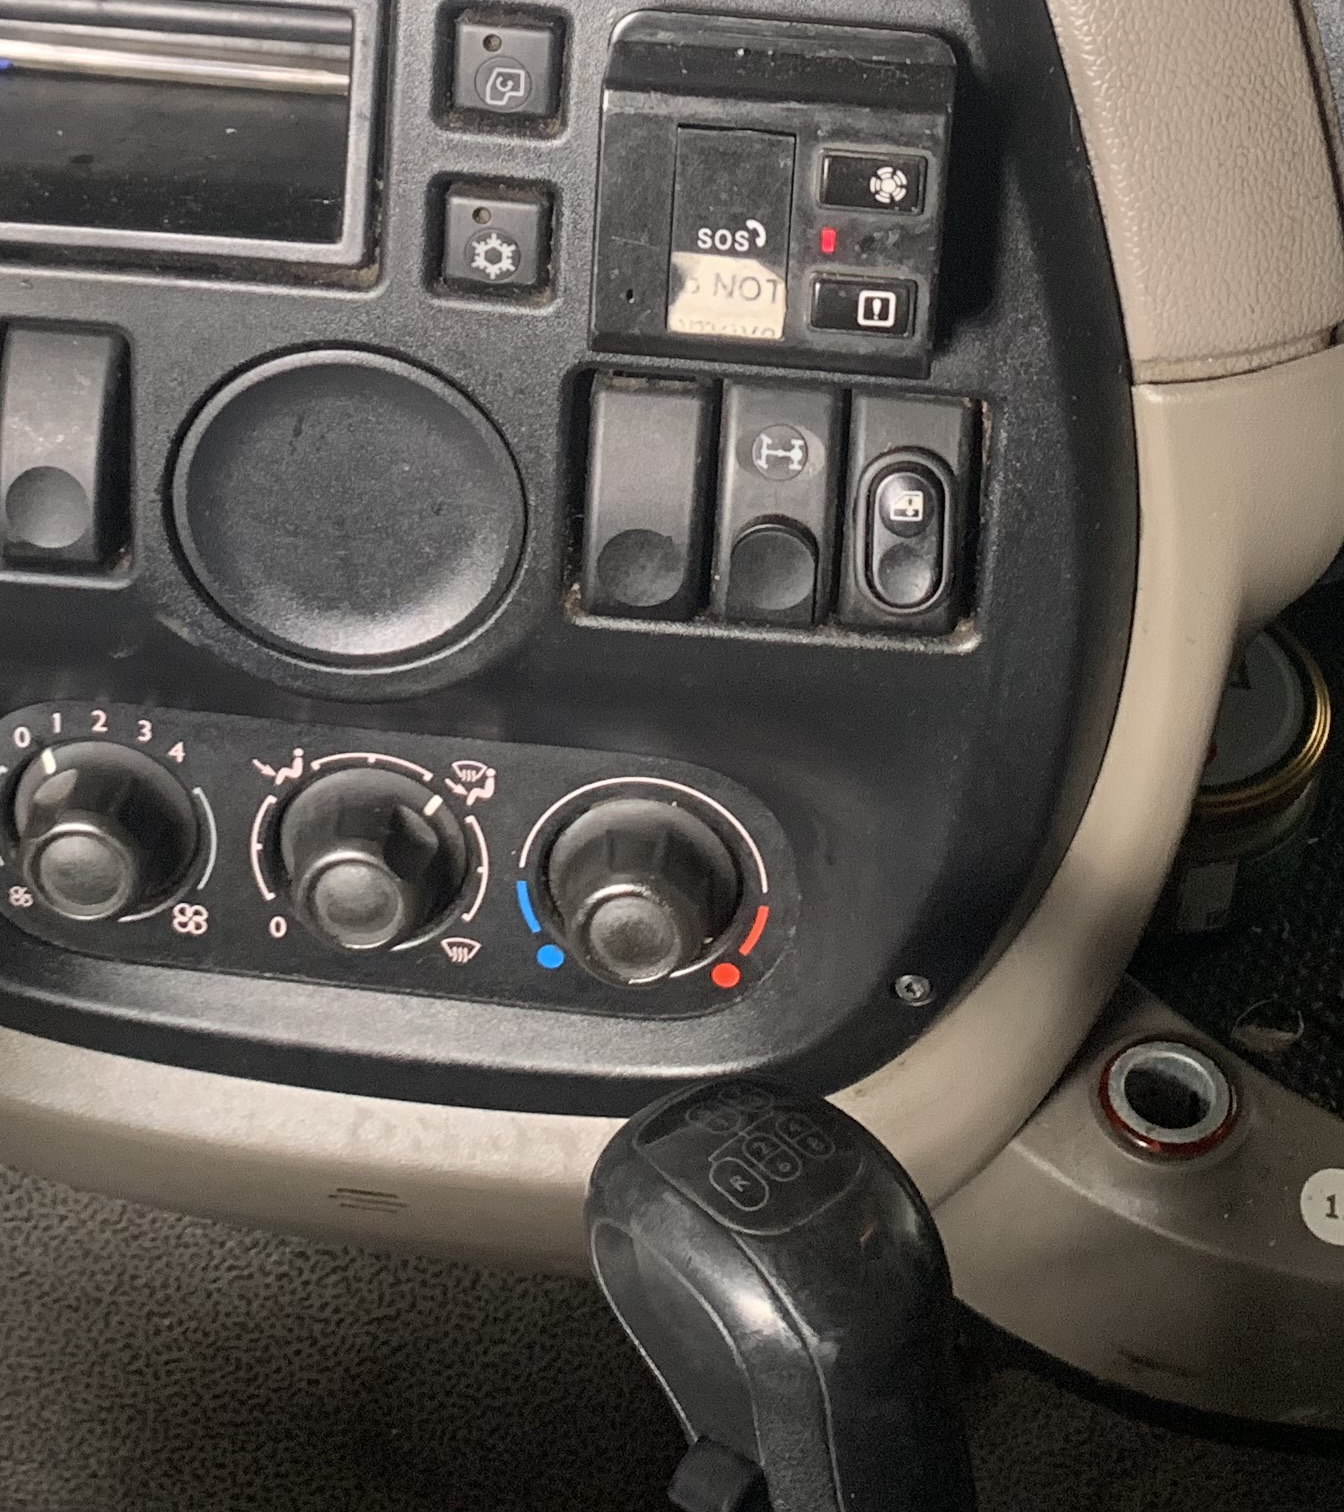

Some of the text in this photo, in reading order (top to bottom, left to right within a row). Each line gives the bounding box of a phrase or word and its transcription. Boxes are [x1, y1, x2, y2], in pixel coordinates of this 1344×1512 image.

[697, 227, 750, 252] SOS
[713, 272, 781, 304] NOT
[13, 709, 186, 763] 0 1 2 3 4
[269, 916, 288, 938] 0
[729, 1175, 751, 1192] R
